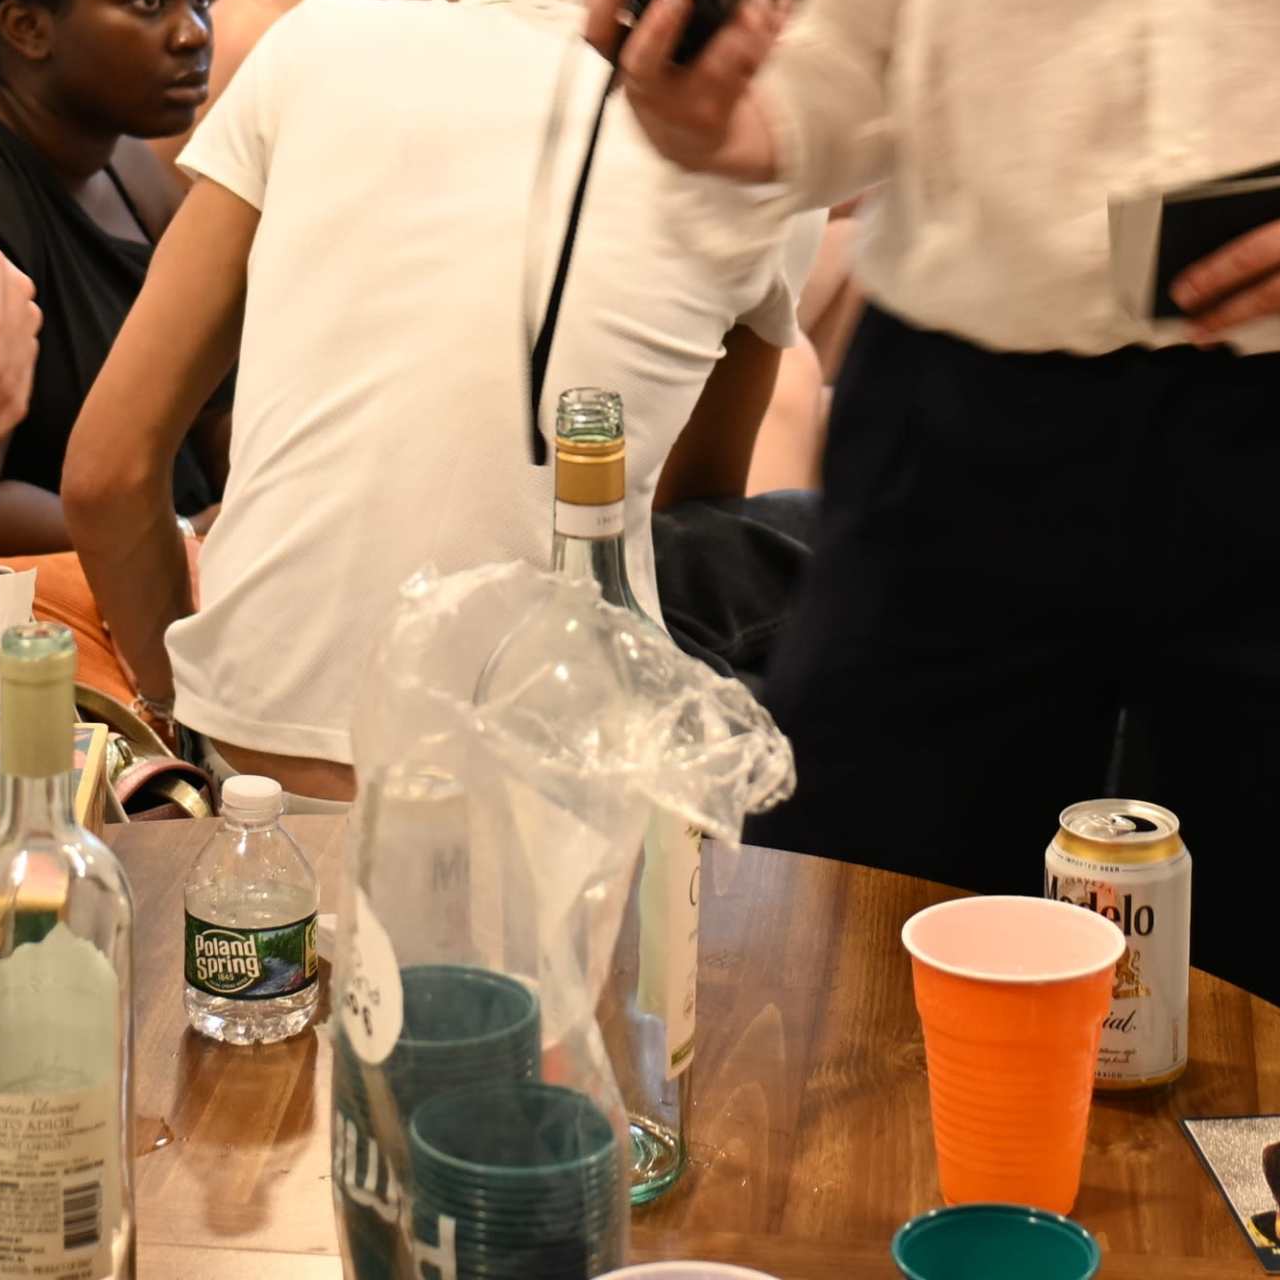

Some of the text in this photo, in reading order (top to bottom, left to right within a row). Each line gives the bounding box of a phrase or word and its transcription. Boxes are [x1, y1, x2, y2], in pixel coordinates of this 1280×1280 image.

[1065, 857, 1120, 873] IMPORTED BEER
[1045, 868, 1155, 937] Melo
[195, 934, 257, 957] Poland
[196, 956, 260, 980] Spring
